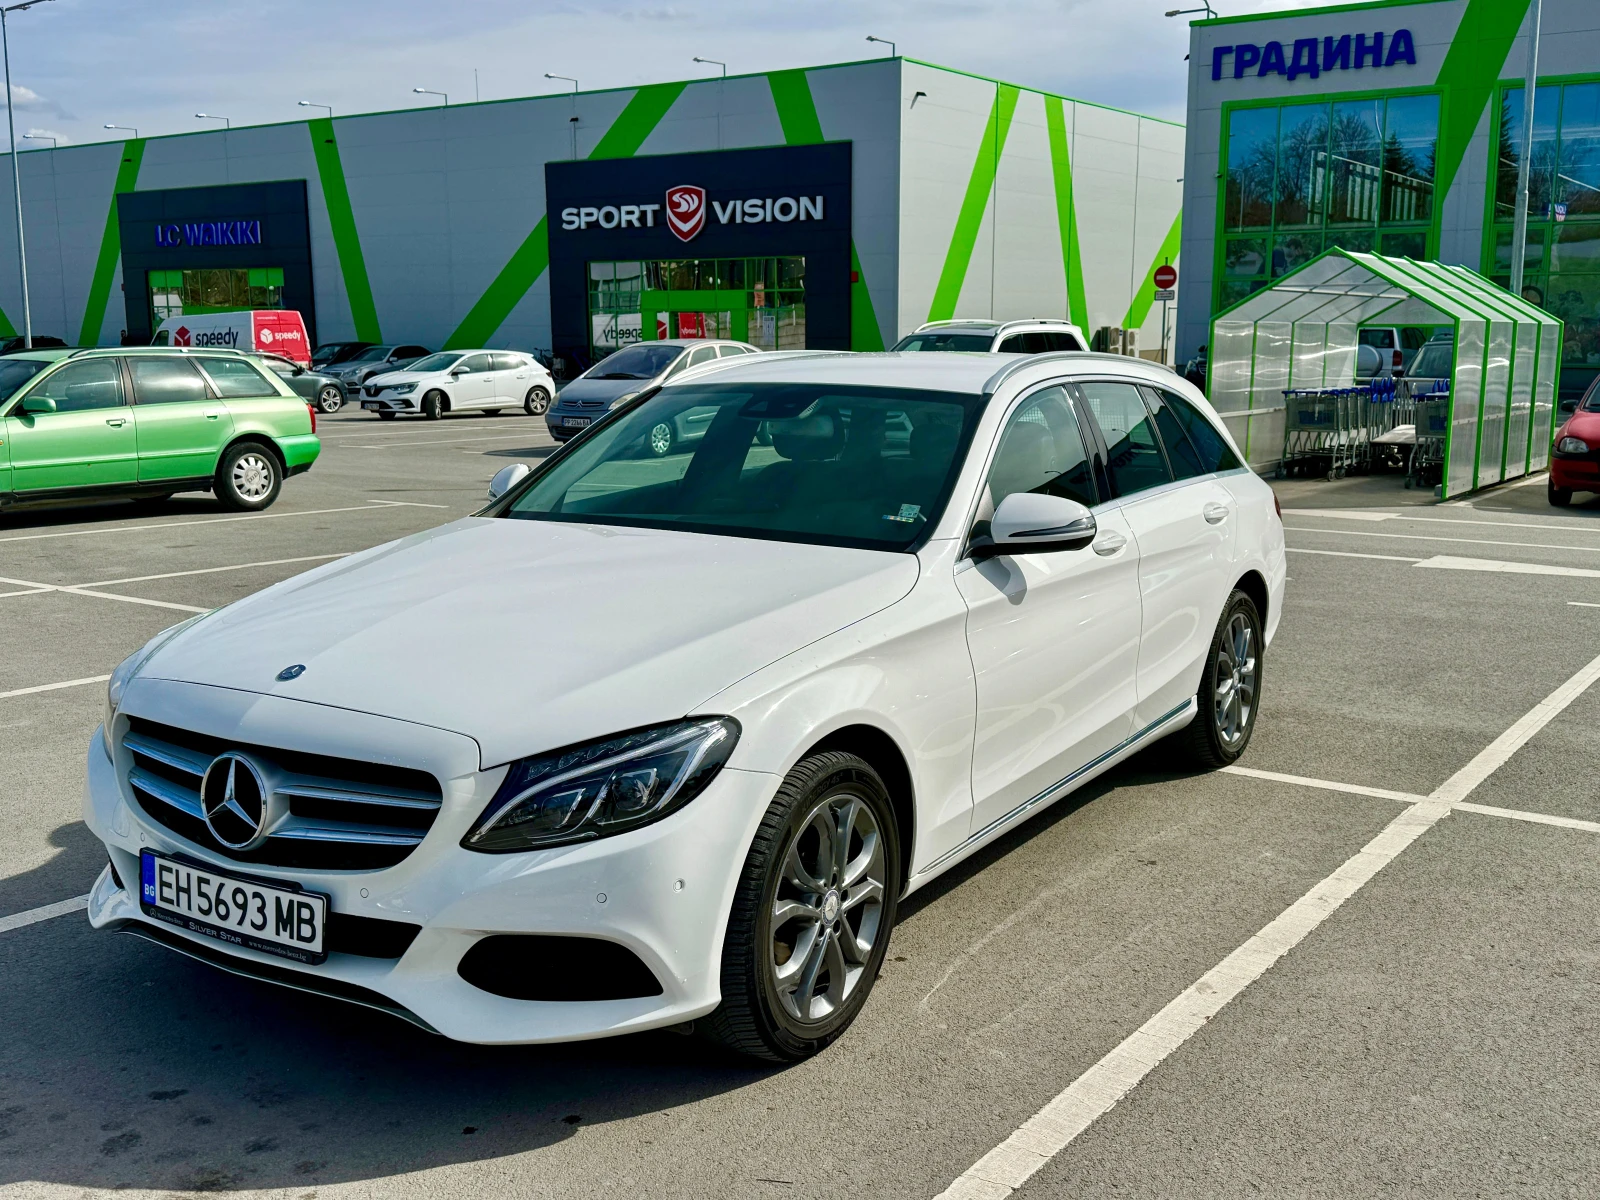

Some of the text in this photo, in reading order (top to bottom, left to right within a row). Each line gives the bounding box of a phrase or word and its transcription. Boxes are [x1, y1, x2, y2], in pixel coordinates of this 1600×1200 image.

[1212, 29, 1416, 80] ГРАДИНА
[561, 204, 660, 230] SPORT
[712, 196, 824, 224] VISION
[155, 224, 180, 247] LC
[195, 326, 239, 348] speedy
[275, 330, 301, 342] speedy
[144, 883, 155, 897] BG
